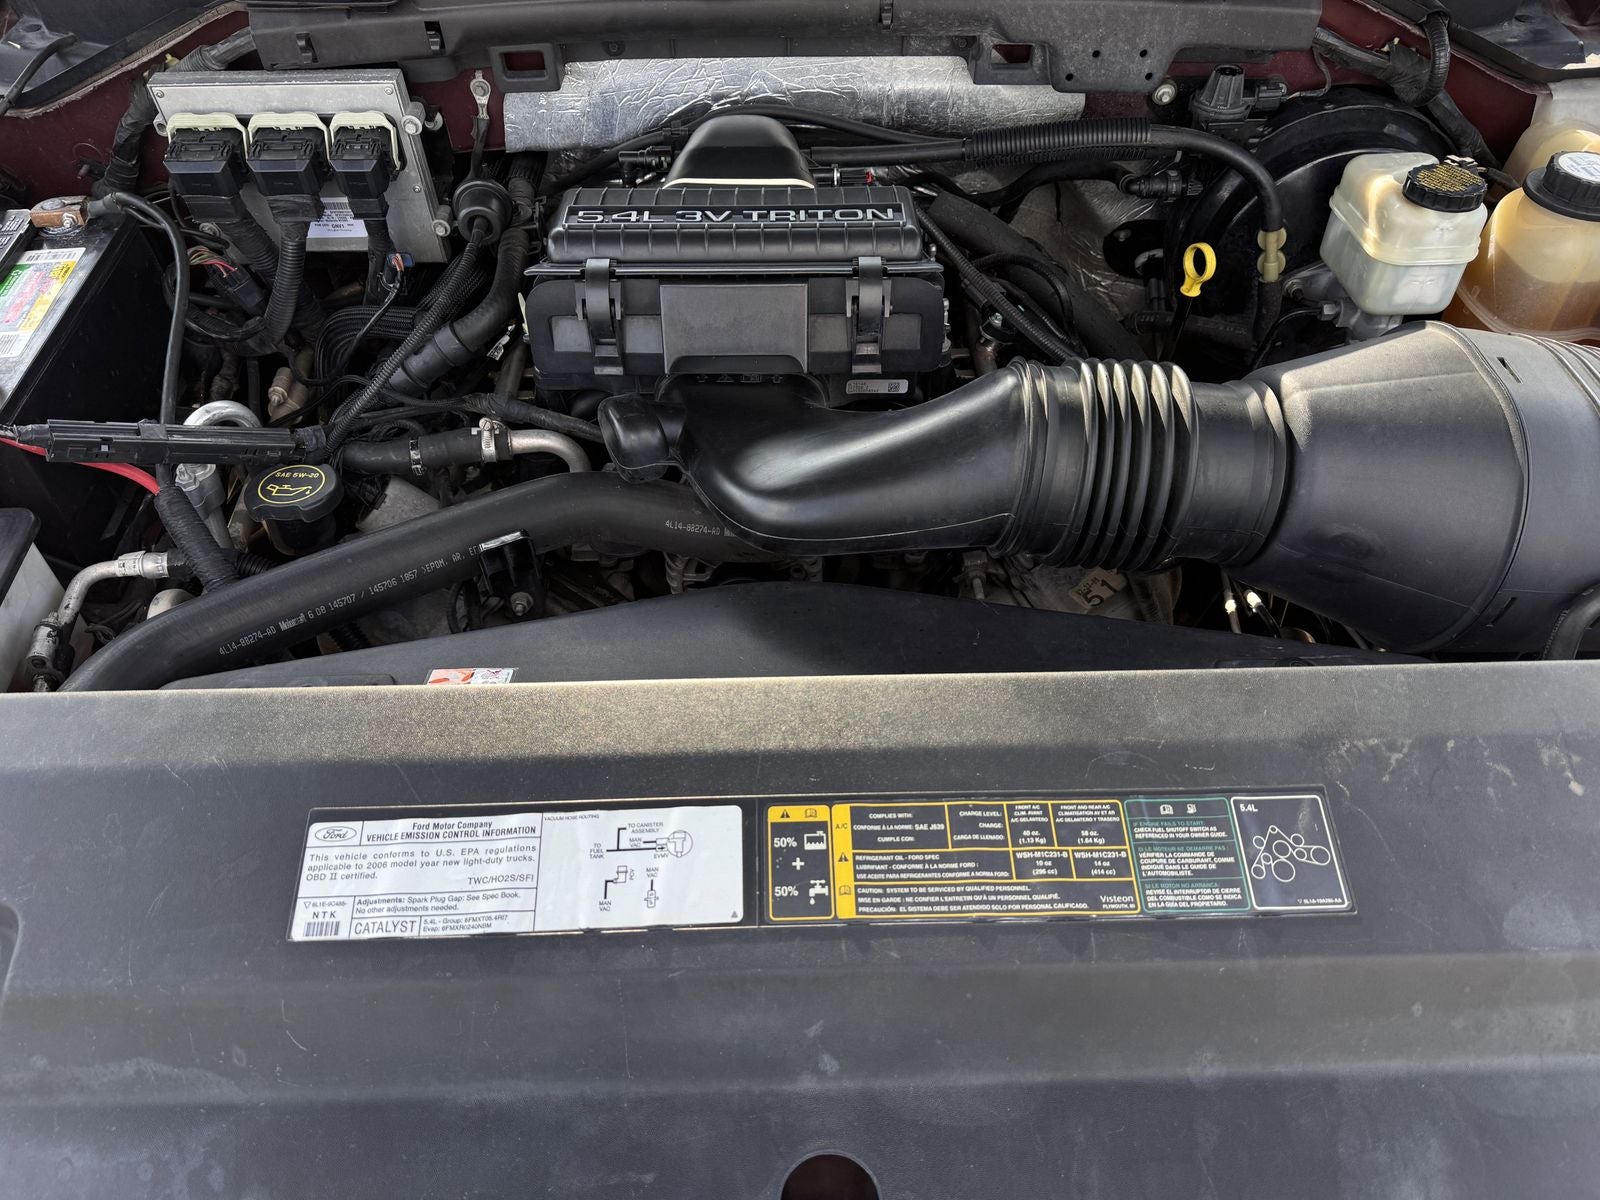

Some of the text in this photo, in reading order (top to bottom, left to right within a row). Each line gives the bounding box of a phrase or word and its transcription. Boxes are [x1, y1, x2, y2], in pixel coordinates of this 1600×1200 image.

[577, 208, 894, 223] 5.4L 3V TRITON
[292, 471, 320, 479] 5W-20
[328, 593, 356, 611] 145707
[368, 577, 398, 595] 145706
[399, 569, 418, 583] 1857
[1239, 803, 1259, 812] 5.4L
[412, 820, 493, 831] Ford Motor Company
[835, 822, 848, 830] A/C
[914, 823, 929, 831] SAE
[322, 828, 349, 840] Ford
[366, 826, 537, 842] VEHICLE EMISSION CONTROL INFORMATION
[773, 836, 798, 848] 50%
[309, 844, 537, 862] This vehicle conforms to U.S. EPA regulations
[307, 862, 352, 872] applicable
[354, 862, 364, 870] to
[366, 861, 388, 870] 2006
[390, 859, 417, 867] model
[419, 859, 439, 869] year
[463, 856, 503, 867] light-duty
[506, 854, 536, 863] trucks.
[305, 871, 379, 881] OBD II certified.
[467, 874, 534, 885] TWC/HO2S/SFI
[774, 885, 799, 897] 50%
[356, 897, 405, 906] Adjustments:
[407, 896, 428, 905] Spark
[429, 895, 446, 904] Plug
[447, 895, 465, 903] Gap:
[482, 893, 500, 901] Spec
[500, 891, 521, 899] Book.
[1099, 894, 1134, 904] Visteon
[355, 907, 366, 915] No
[386, 904, 429, 913] adjustments
[430, 903, 459, 911] needed.
[354, 920, 417, 935] CATALYST
